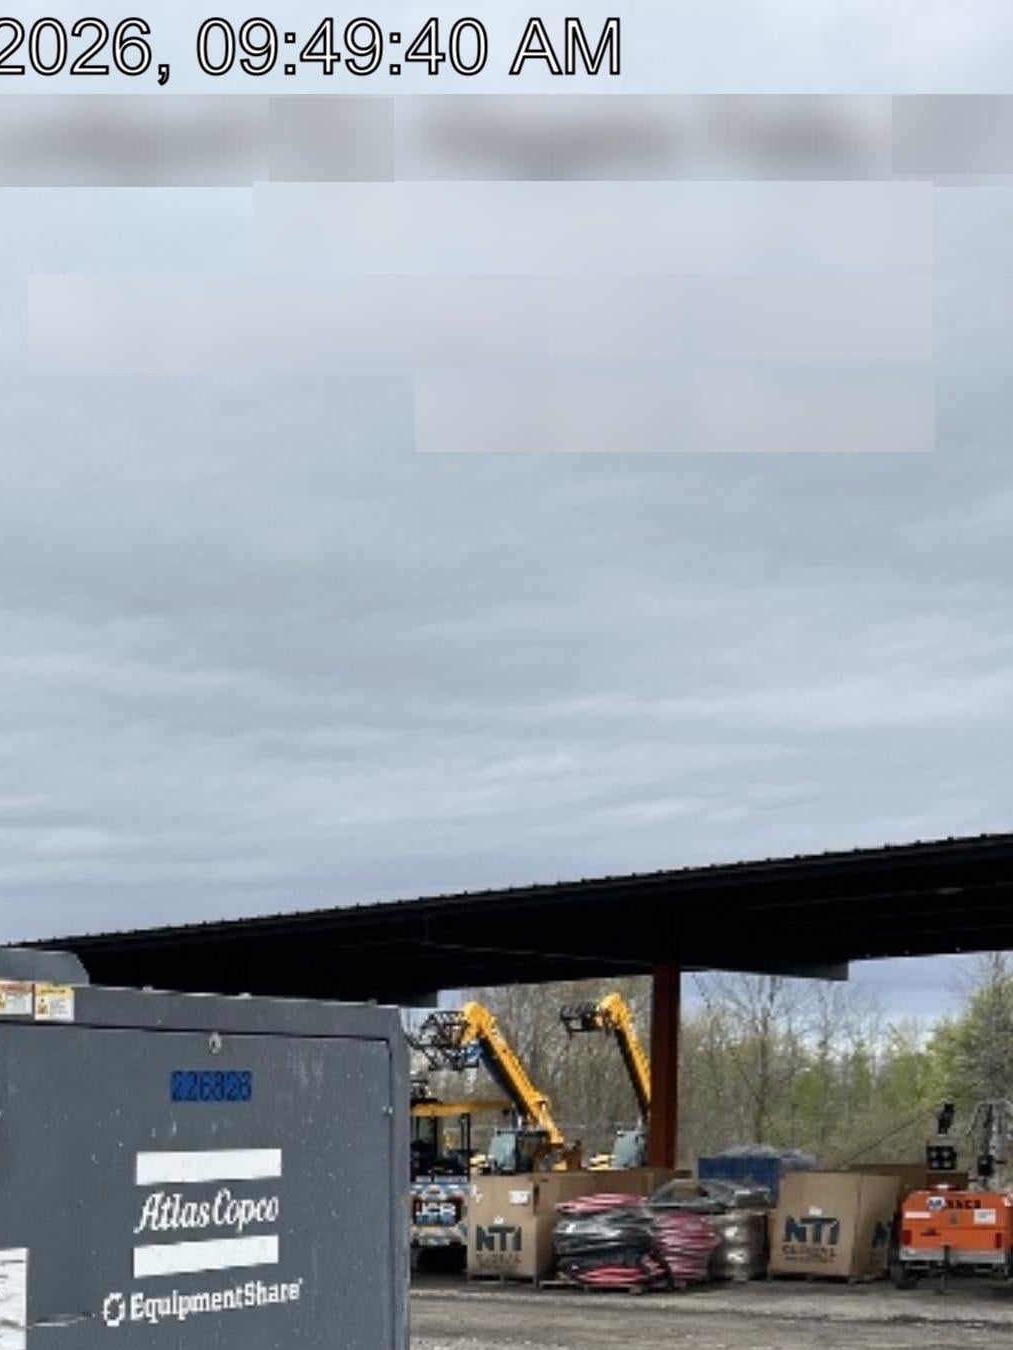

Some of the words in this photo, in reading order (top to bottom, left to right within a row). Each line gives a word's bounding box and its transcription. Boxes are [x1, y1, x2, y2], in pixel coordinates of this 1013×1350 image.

[134, 1192, 209, 1233] Atlas
[211, 1187, 280, 1232] Copco
[129, 1281, 301, 1324] EquipmentShare
